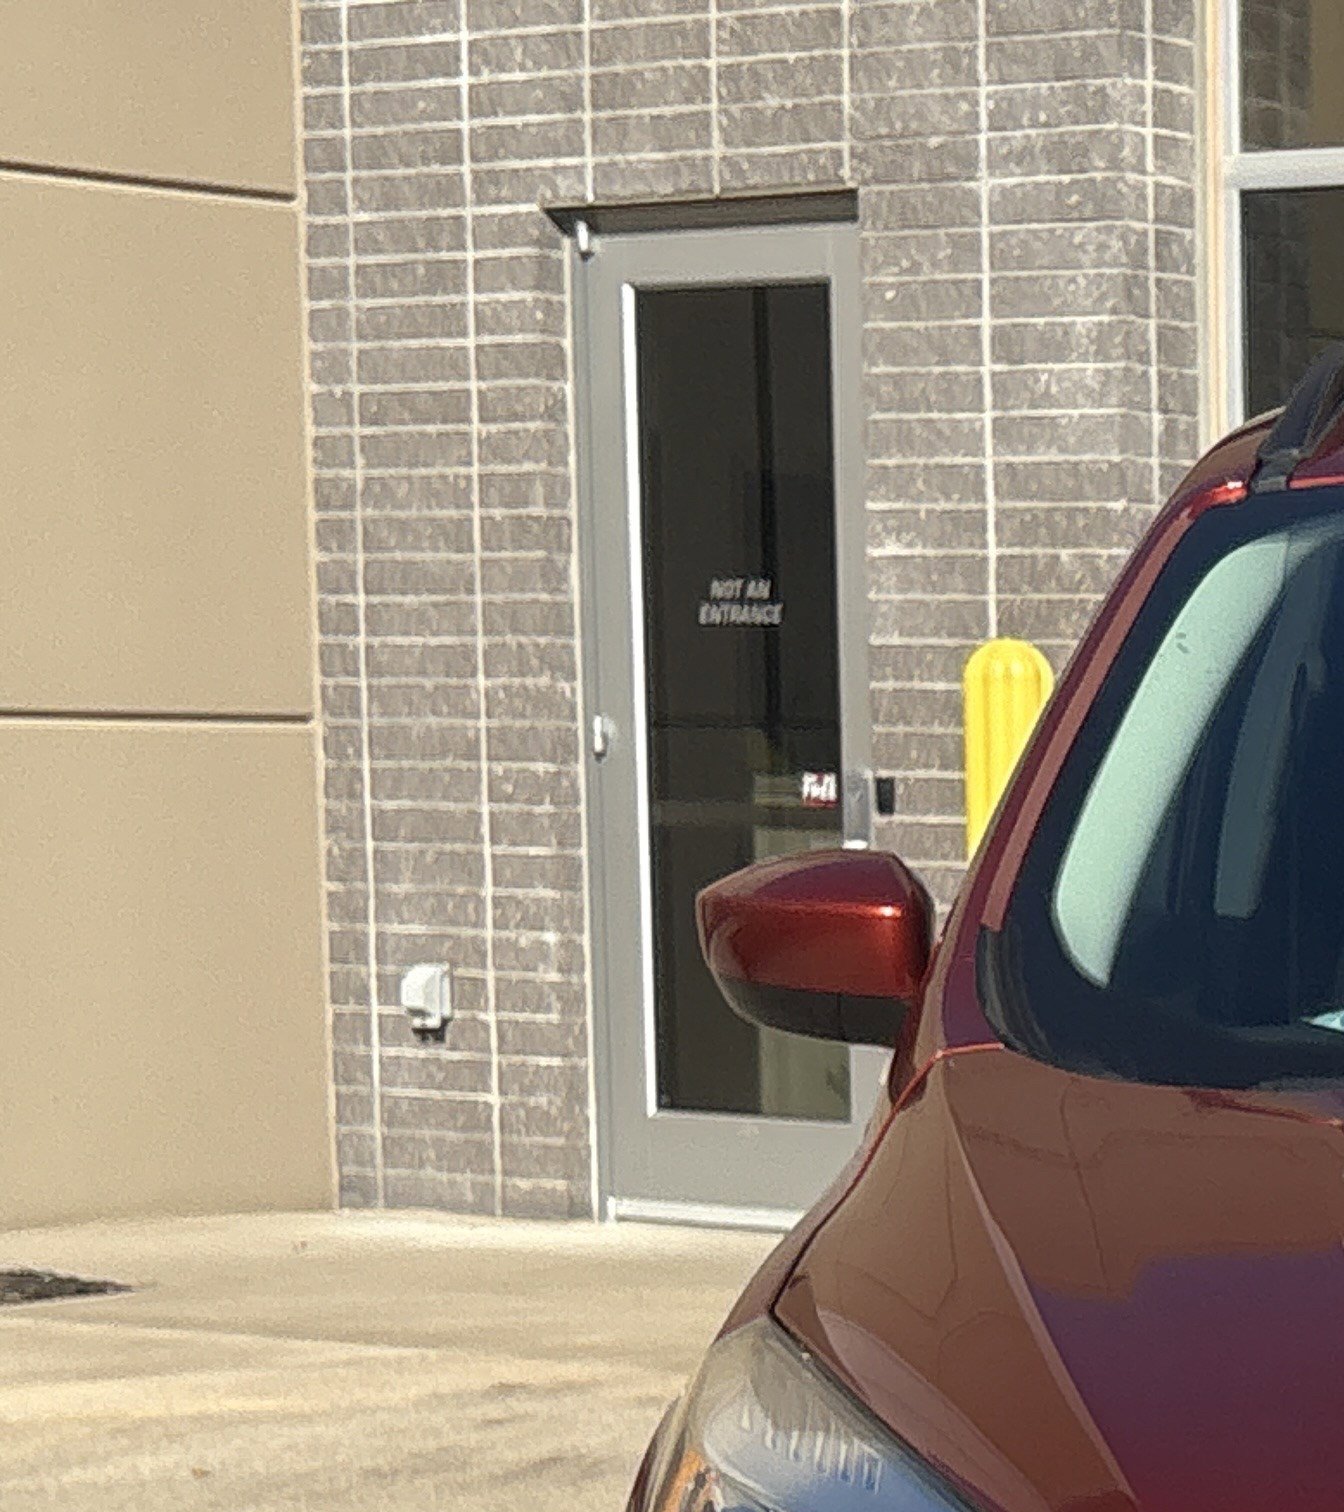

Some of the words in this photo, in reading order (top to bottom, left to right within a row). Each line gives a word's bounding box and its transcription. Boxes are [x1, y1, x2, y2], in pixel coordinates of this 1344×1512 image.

[710, 578, 744, 599] NOT
[746, 578, 772, 599] AN
[698, 602, 784, 626] ENTRANCE
